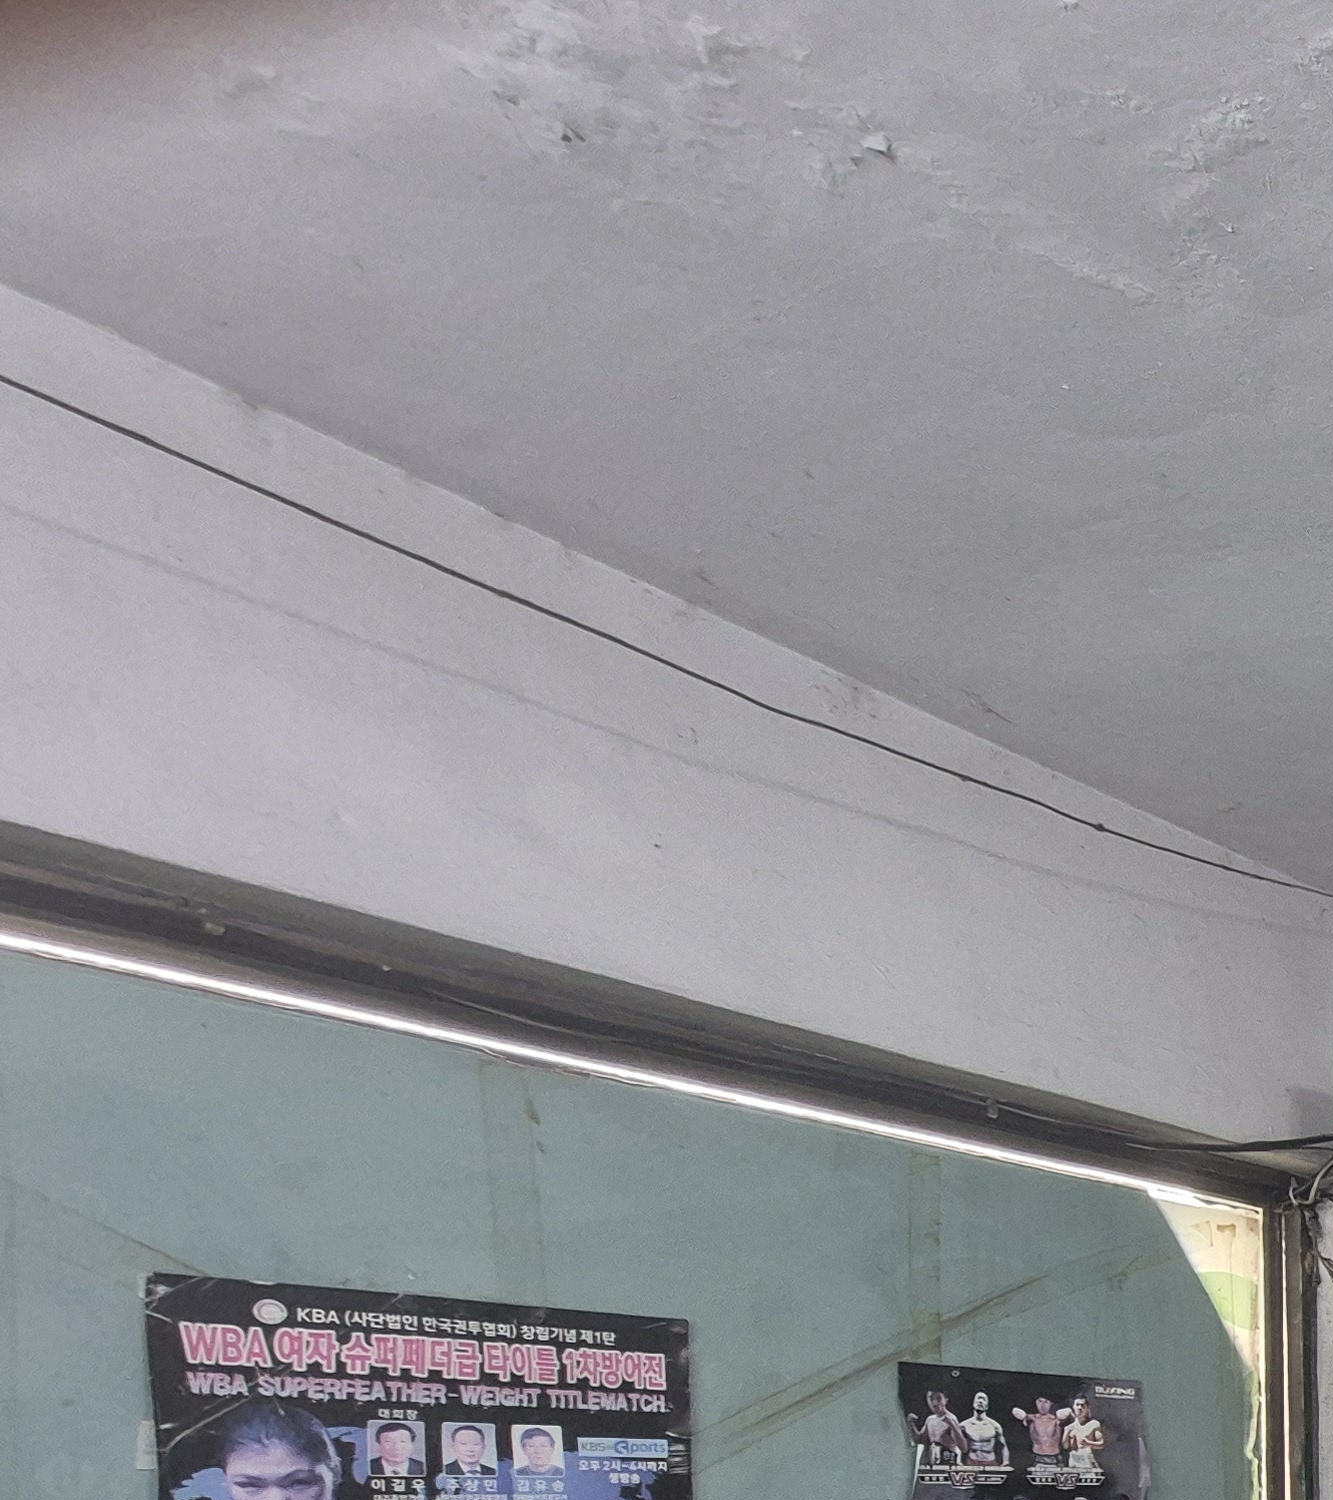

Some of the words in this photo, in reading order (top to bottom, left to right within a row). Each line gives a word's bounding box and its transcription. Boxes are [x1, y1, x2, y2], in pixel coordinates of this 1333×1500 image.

[296, 1308, 341, 1325] KBA
[345, 1309, 418, 1332] (사단법인
[422, 1315, 518, 1339] 한국권투협회)
[520, 1325, 577, 1344] 창립기념
[580, 1329, 617, 1346] 제1탄
[178, 1321, 274, 1368] WBA
[274, 1327, 341, 1374] 여자
[341, 1331, 482, 1380] 슈퍼페더급
[483, 1341, 560, 1385] 타이틀
[562, 1348, 668, 1391] 1차방어전
[184, 1371, 249, 1397] WBA
[951, 1471, 976, 1487] VS
[1055, 1472, 1078, 1487] VS
